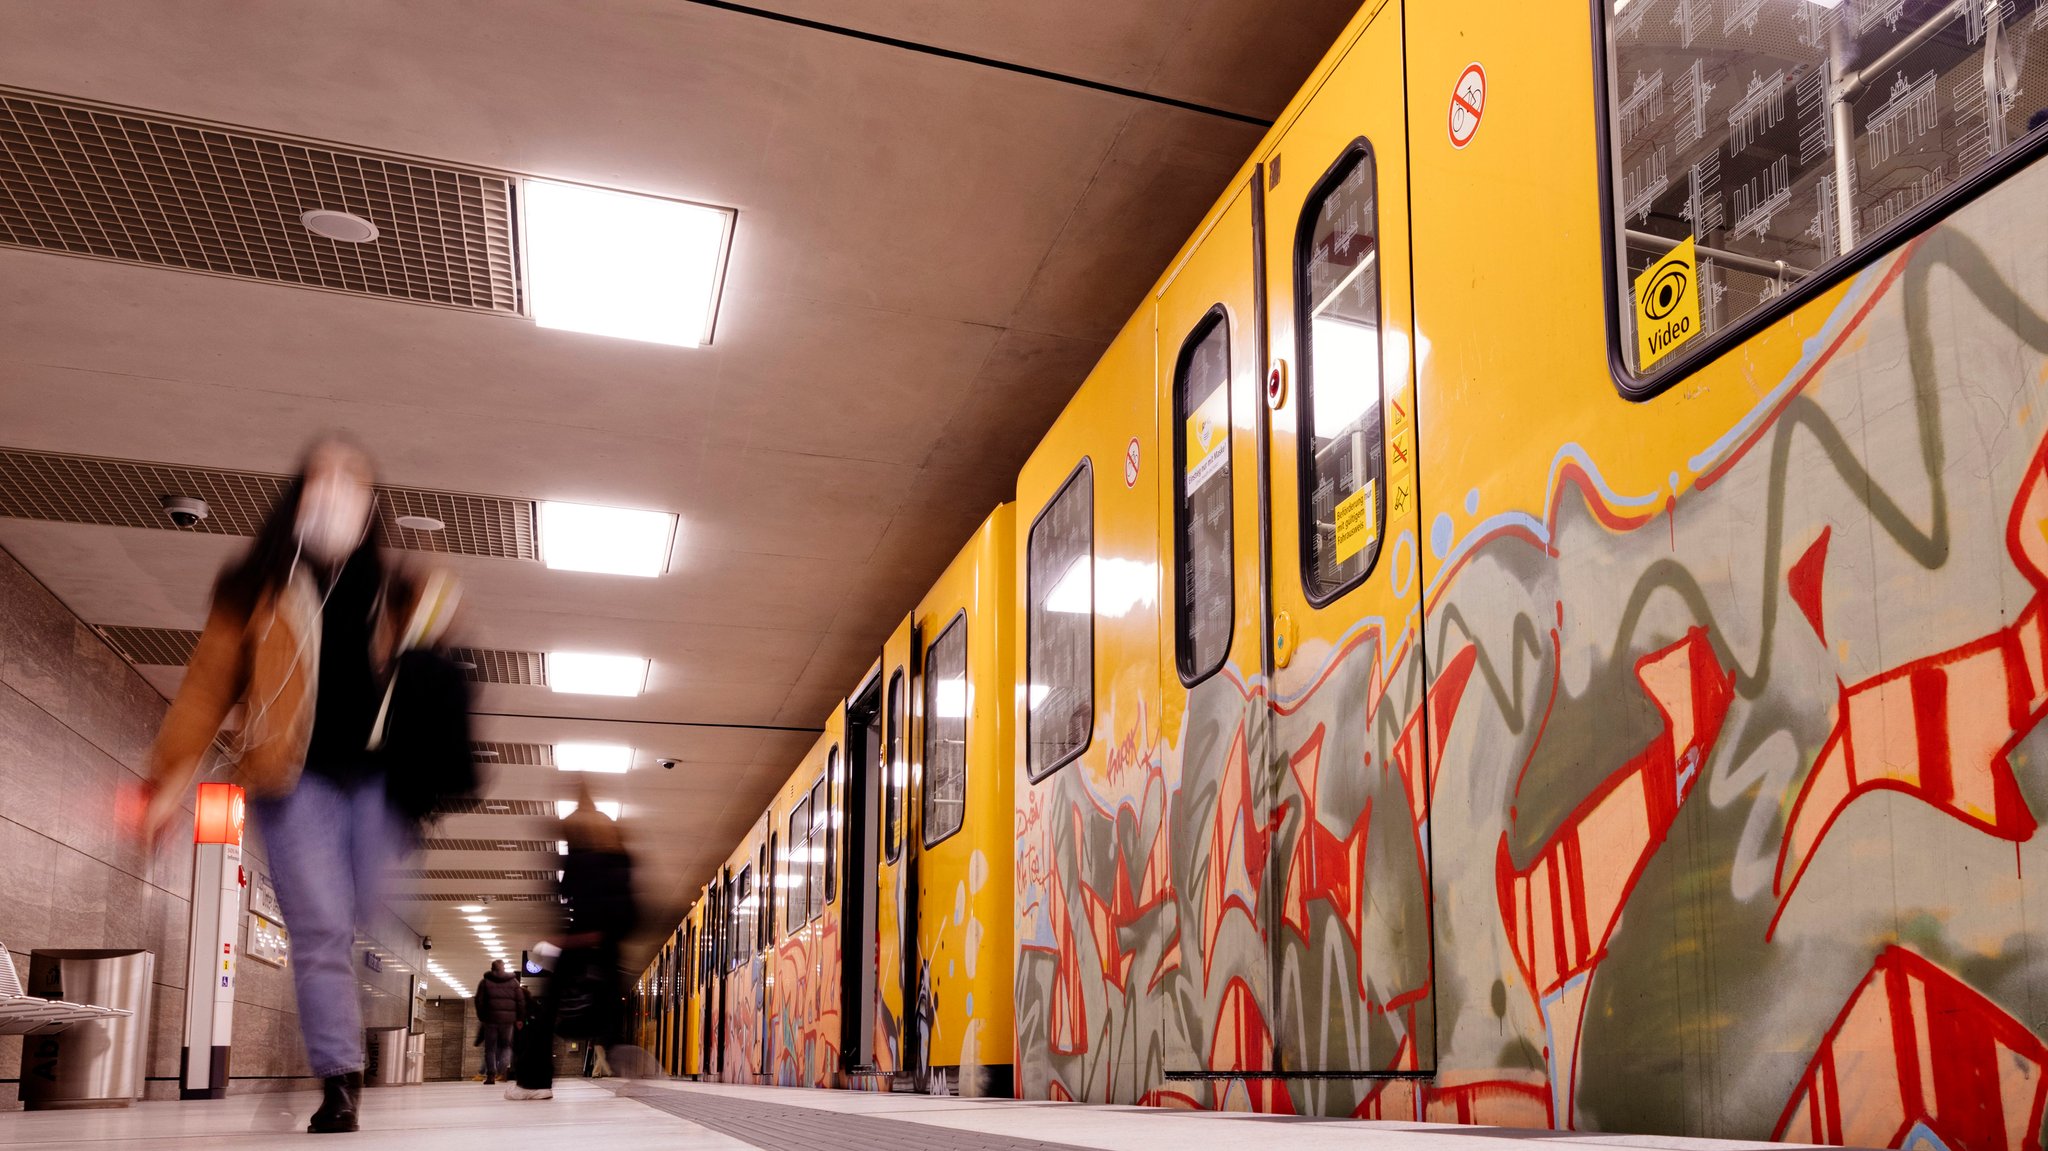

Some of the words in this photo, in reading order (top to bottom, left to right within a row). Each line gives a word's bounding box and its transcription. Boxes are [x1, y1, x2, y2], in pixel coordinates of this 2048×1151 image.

[1648, 316, 1690, 355] Video
[1337, 495, 1364, 520] Beförderung
[1345, 508, 1365, 530] gültigem
[1337, 521, 1364, 545] Fahrausweis
